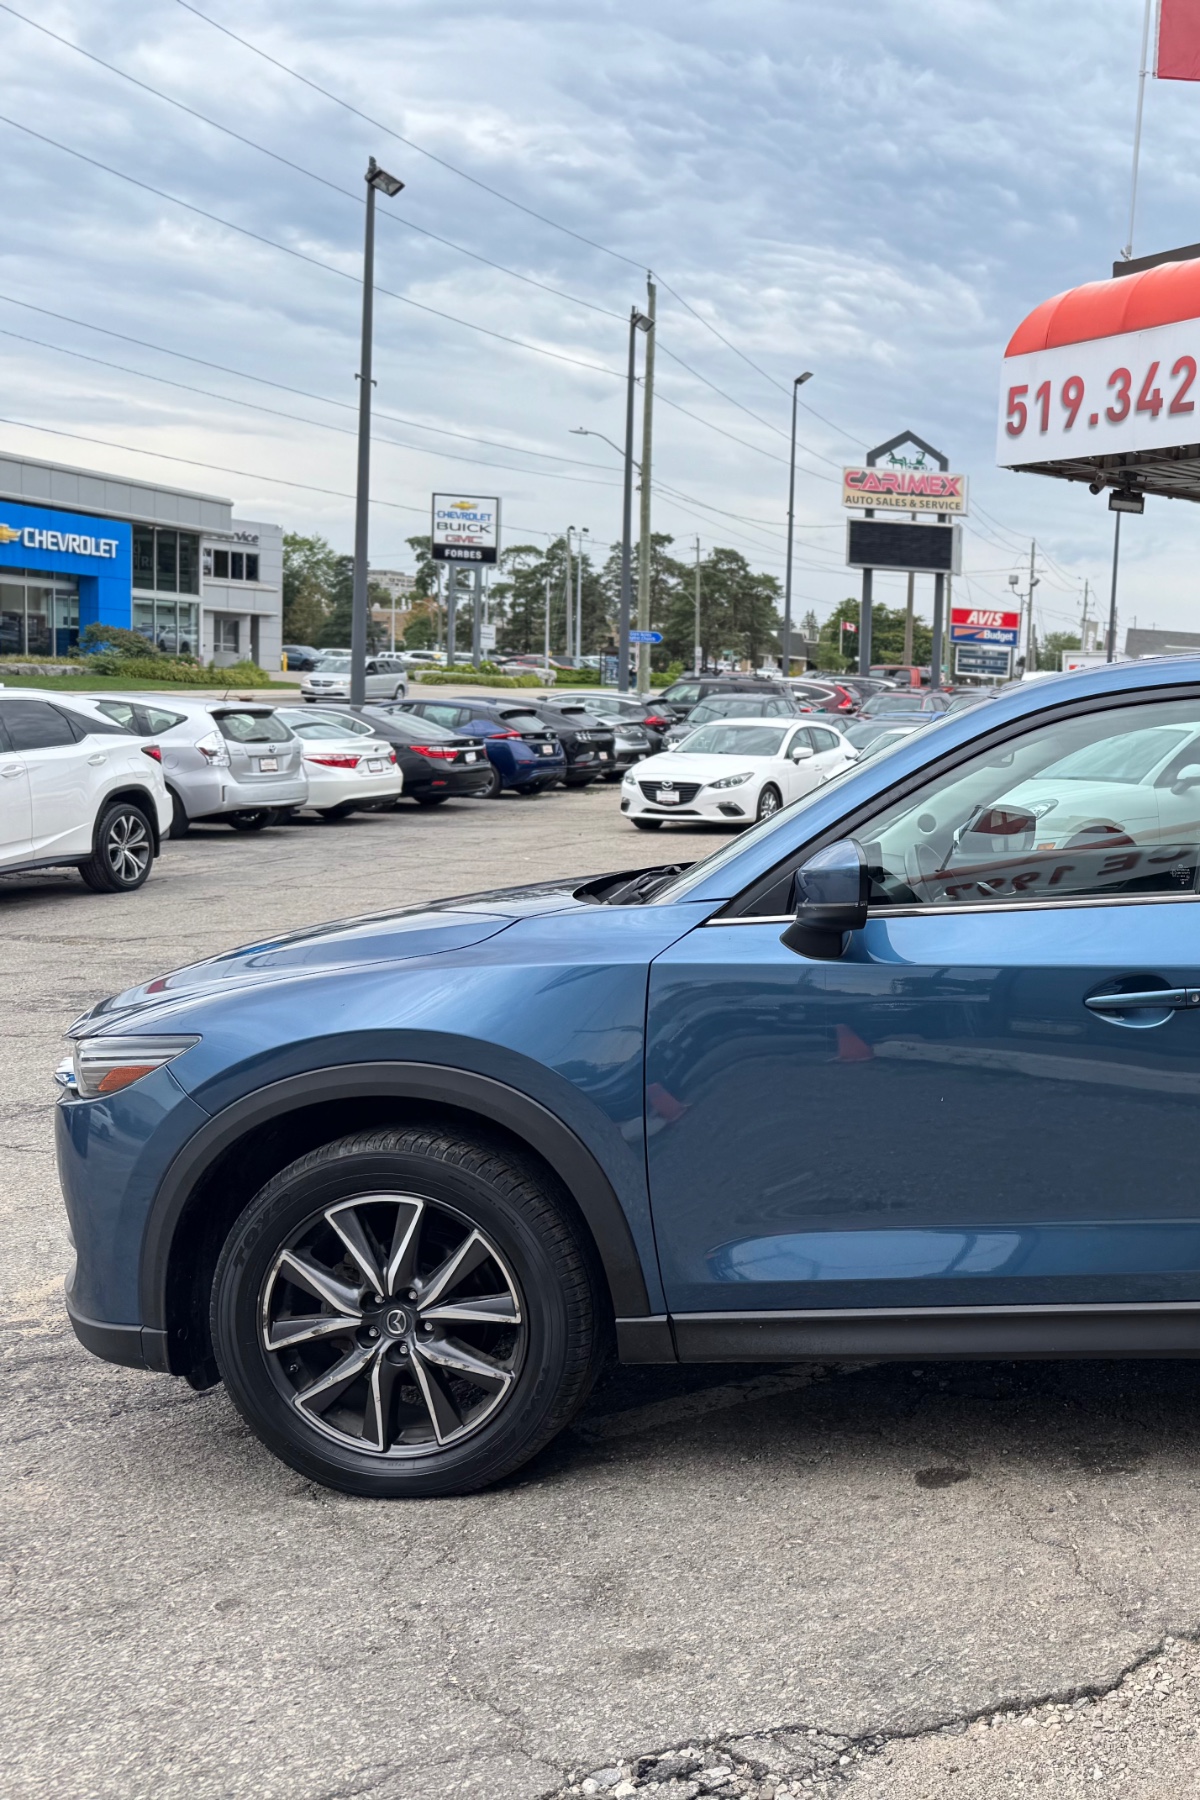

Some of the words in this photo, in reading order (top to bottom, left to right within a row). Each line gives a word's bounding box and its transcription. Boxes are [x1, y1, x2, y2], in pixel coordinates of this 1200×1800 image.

[844, 470, 962, 496] CARIMEX
[845, 495, 874, 506] AUTO
[875, 496, 908, 507] SALES
[909, 498, 917, 508] &
[919, 499, 961, 511] SERVICE
[437, 510, 492, 521] CHEVROLET
[436, 521, 492, 534] BUICK
[23, 526, 119, 559] CHEVROLET
[445, 534, 484, 545] GMC
[444, 549, 483, 560] FORBES
[966, 610, 1005, 627] AVIS
[983, 629, 1014, 643] Budget
